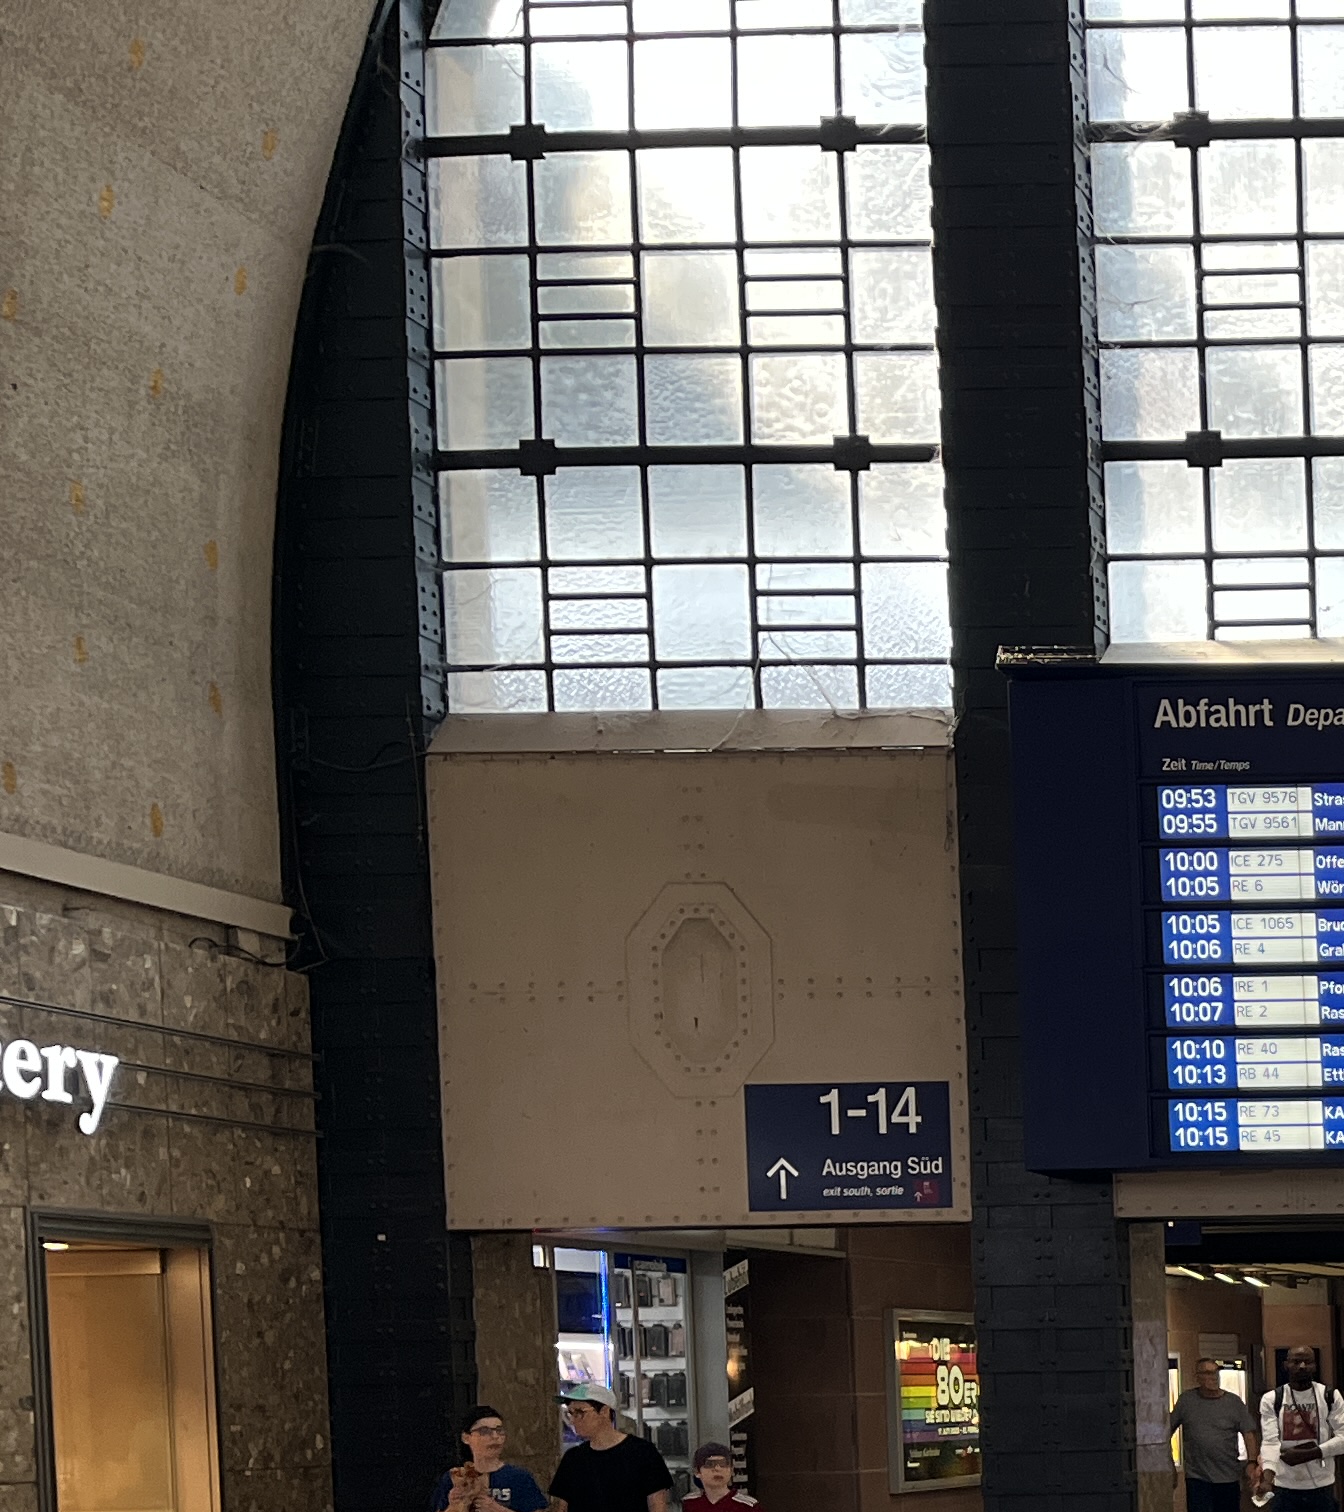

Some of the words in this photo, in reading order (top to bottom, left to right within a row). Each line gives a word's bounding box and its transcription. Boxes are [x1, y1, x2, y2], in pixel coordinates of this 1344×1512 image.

[1154, 698, 1273, 729] Abfahrt
[1162, 758, 1187, 772] Zeit
[1162, 789, 1216, 808] 09:53
[1163, 814, 1217, 833] 09:55
[1165, 851, 1218, 871] 10:00
[1167, 877, 1219, 896] 10:05
[1168, 915, 1220, 934] 10:05
[1169, 940, 1221, 959] 10:06
[1170, 977, 1222, 997] 10:06
[1171, 1002, 1223, 1022] 10:07
[1172, 1040, 1224, 1059] 10:10
[1173, 1065, 1226, 1084] 10:13
[0, 1038, 119, 1136] ery
[819, 1086, 922, 1135] 1-14
[1174, 1102, 1226, 1121] 10:15
[1175, 1127, 1228, 1146] 10:15
[821, 1158, 901, 1179] Ausgang
[907, 1156, 943, 1175] Süd
[823, 1186, 841, 1197] exit
[843, 1186, 873, 1197] south,
[876, 1185, 904, 1196] sortie
